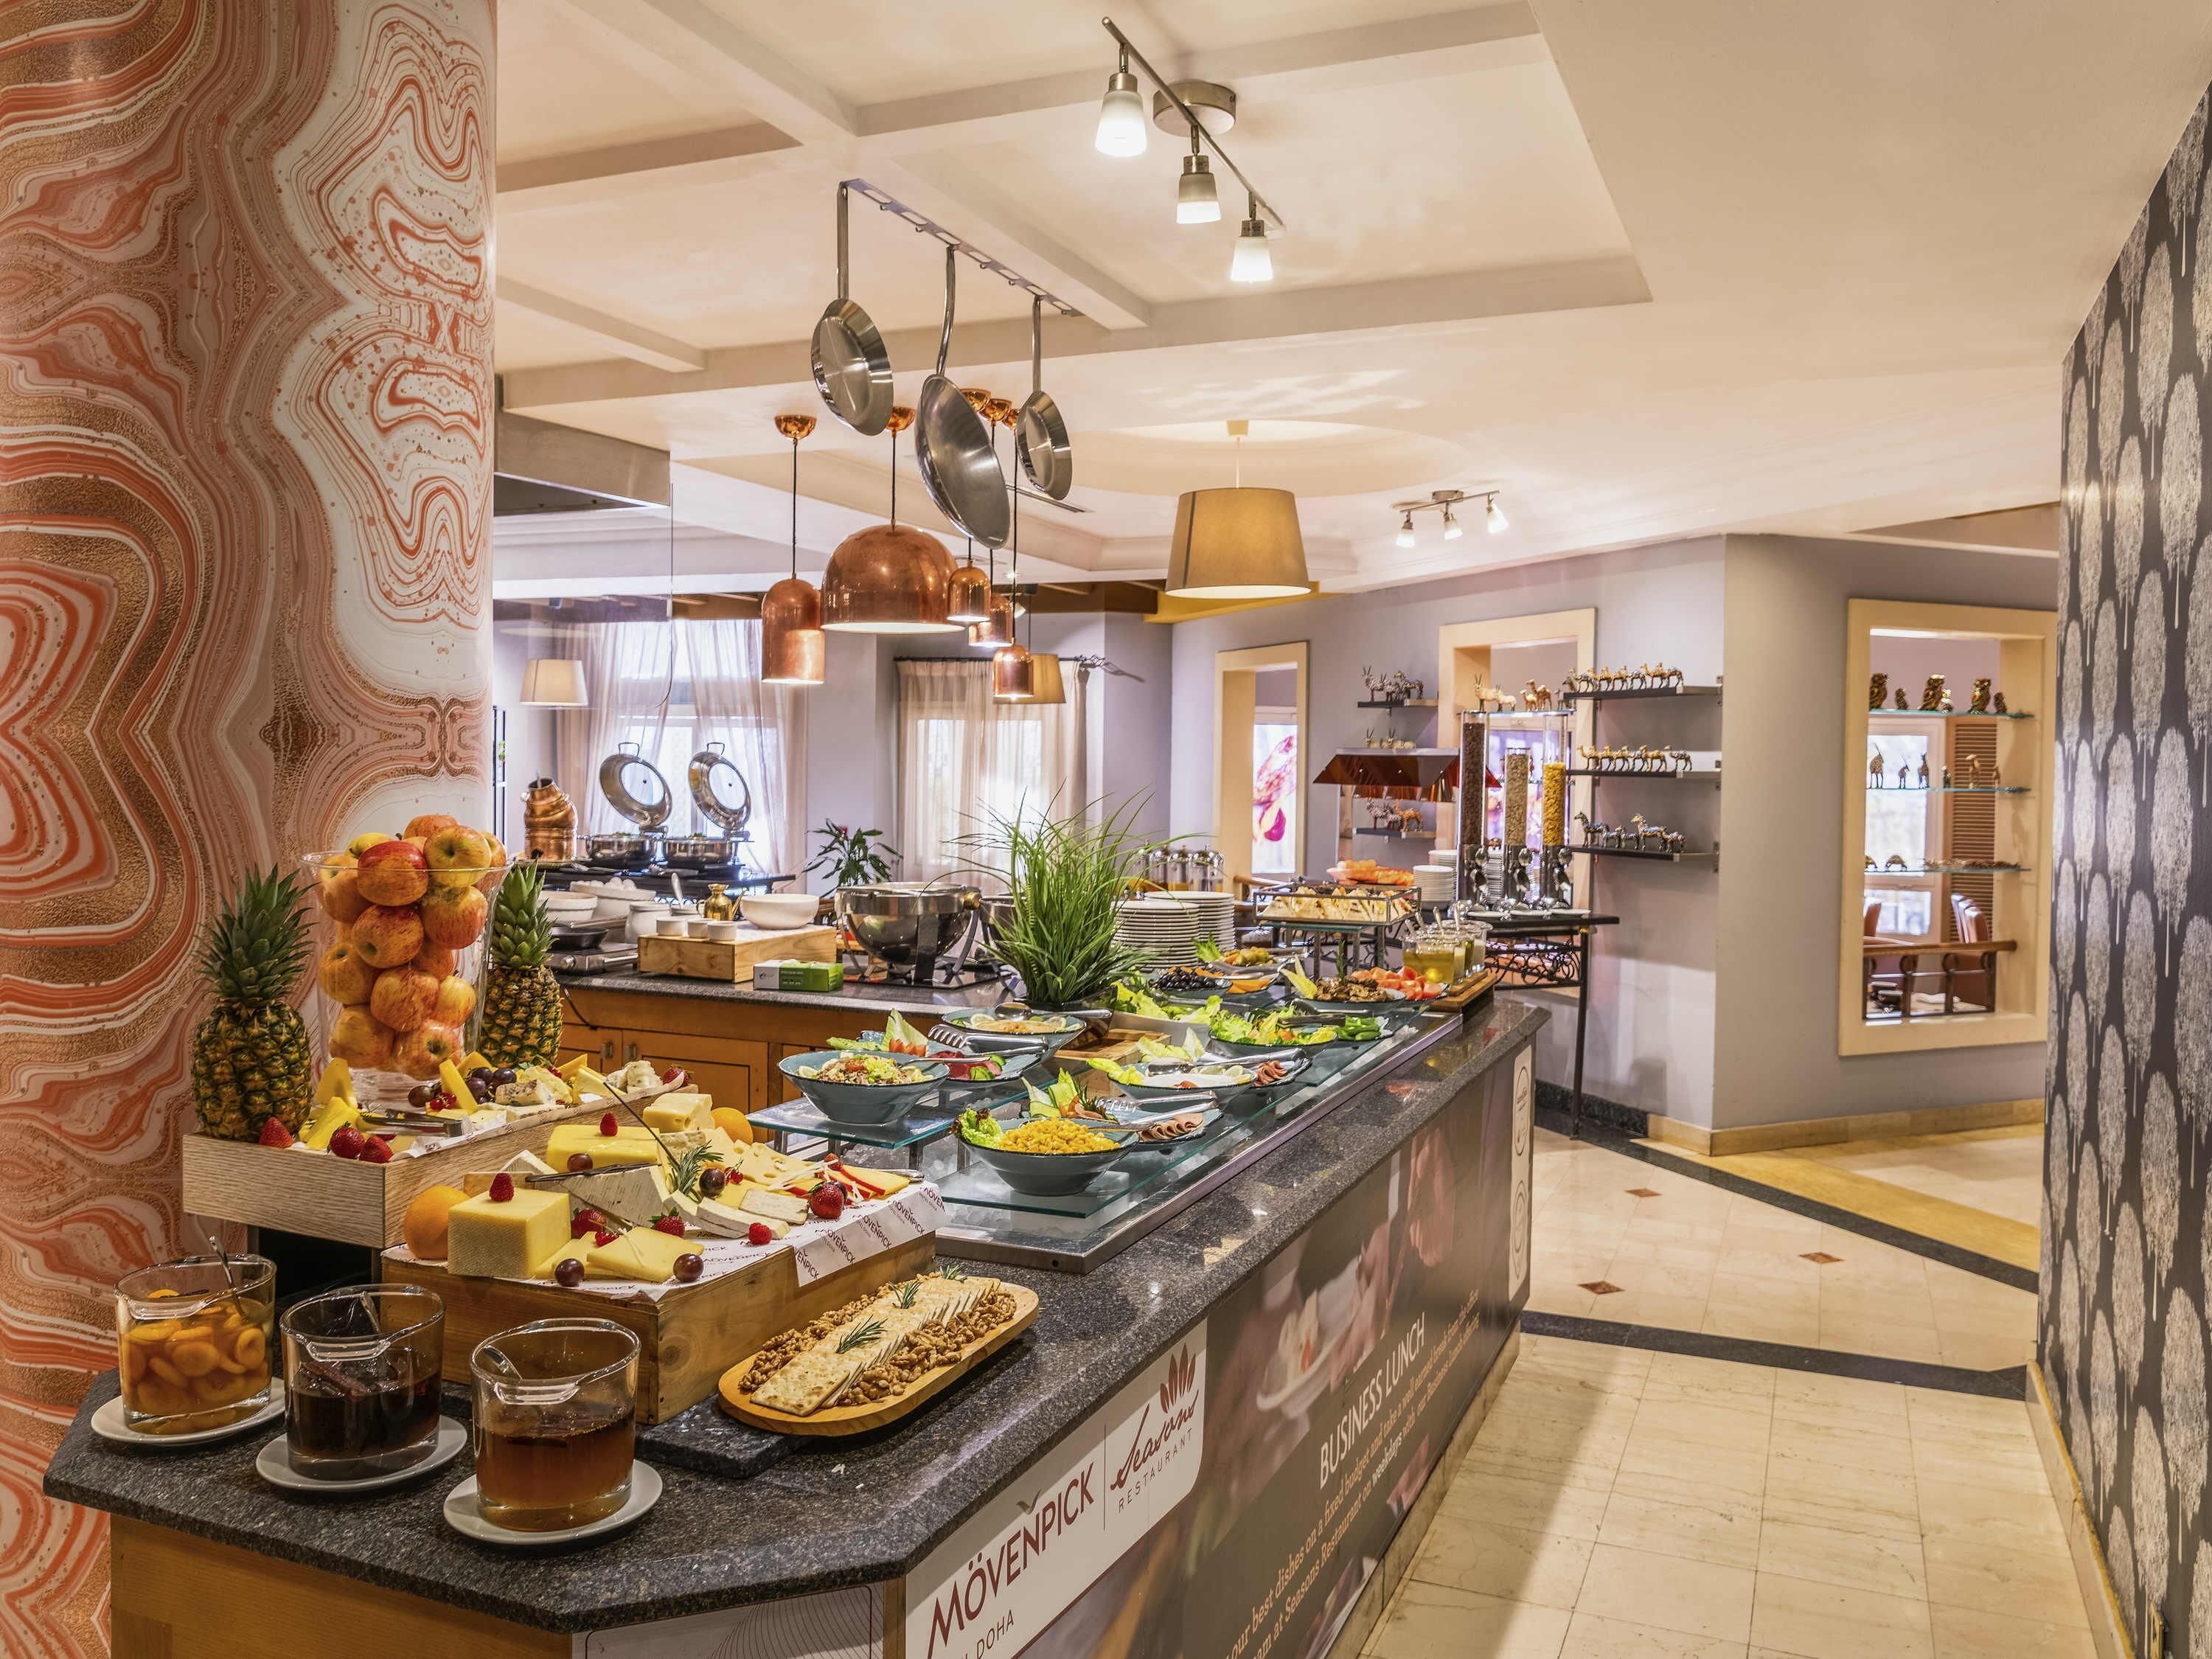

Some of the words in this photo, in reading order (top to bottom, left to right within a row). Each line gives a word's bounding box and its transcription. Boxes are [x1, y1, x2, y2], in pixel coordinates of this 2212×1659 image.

[1110, 1388, 1200, 1491] Seasons
[1118, 1427, 1192, 1513] RESTAURANT
[1320, 1368, 1382, 1491] BUSINESS
[1385, 1311, 1425, 1398] LUNCH
[927, 1461, 1094, 1659] MÖVENPICK
[1252, 1587, 1274, 1635] best
[1275, 1545, 1305, 1599] dishes
[1305, 1528, 1318, 1554] on
[1318, 1518, 1324, 1536] a
[1324, 1478, 1344, 1527] fixed
[1345, 1449, 1369, 1496] budget
[1370, 1422, 1383, 1458] and
[1383, 1409, 1397, 1439] take
[1273, 1611, 1284, 1641] at
[1285, 1559, 1320, 1622] Seasons
[1321, 1492, 1363, 1568] Restaurant
[1362, 1480, 1372, 1502] on
[1371, 1431, 1402, 1487] weekdays
[976, 1609, 1014, 1659] DOHA
